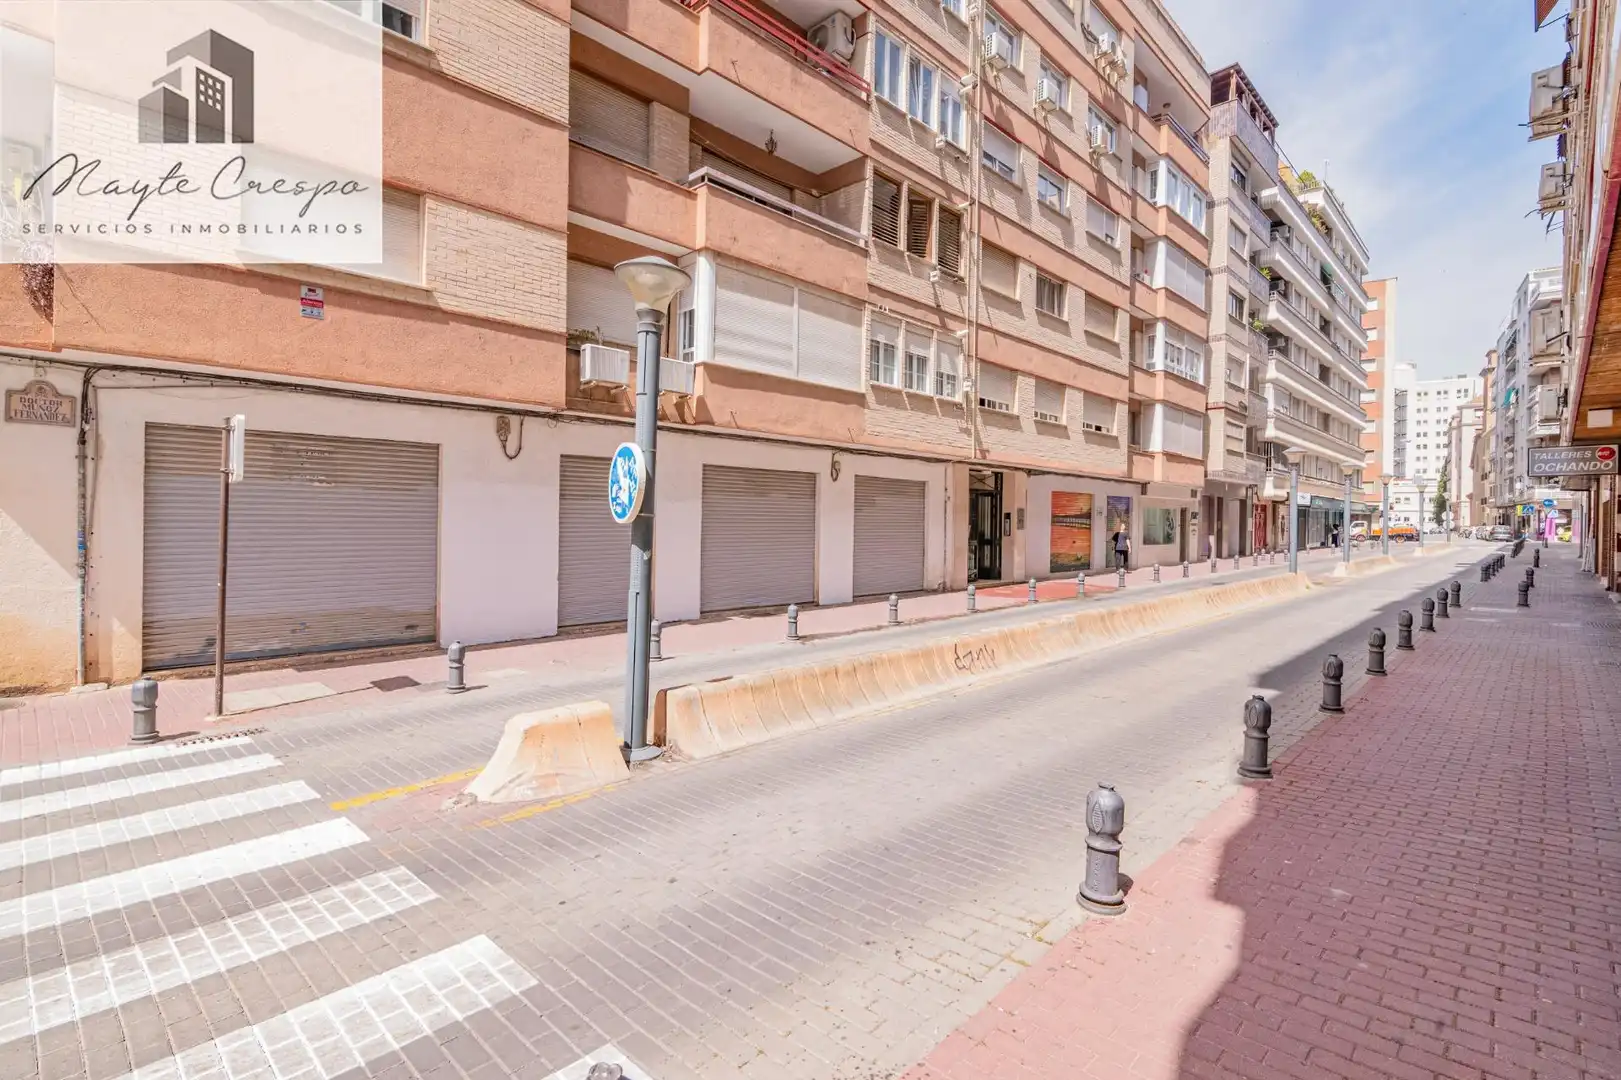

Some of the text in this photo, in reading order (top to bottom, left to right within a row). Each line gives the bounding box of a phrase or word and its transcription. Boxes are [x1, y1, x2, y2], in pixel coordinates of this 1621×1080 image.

[19, 396, 63, 407] DOCTOR
[1534, 450, 1592, 460] TALLERES
[1534, 461, 1613, 472] OCHANDO
